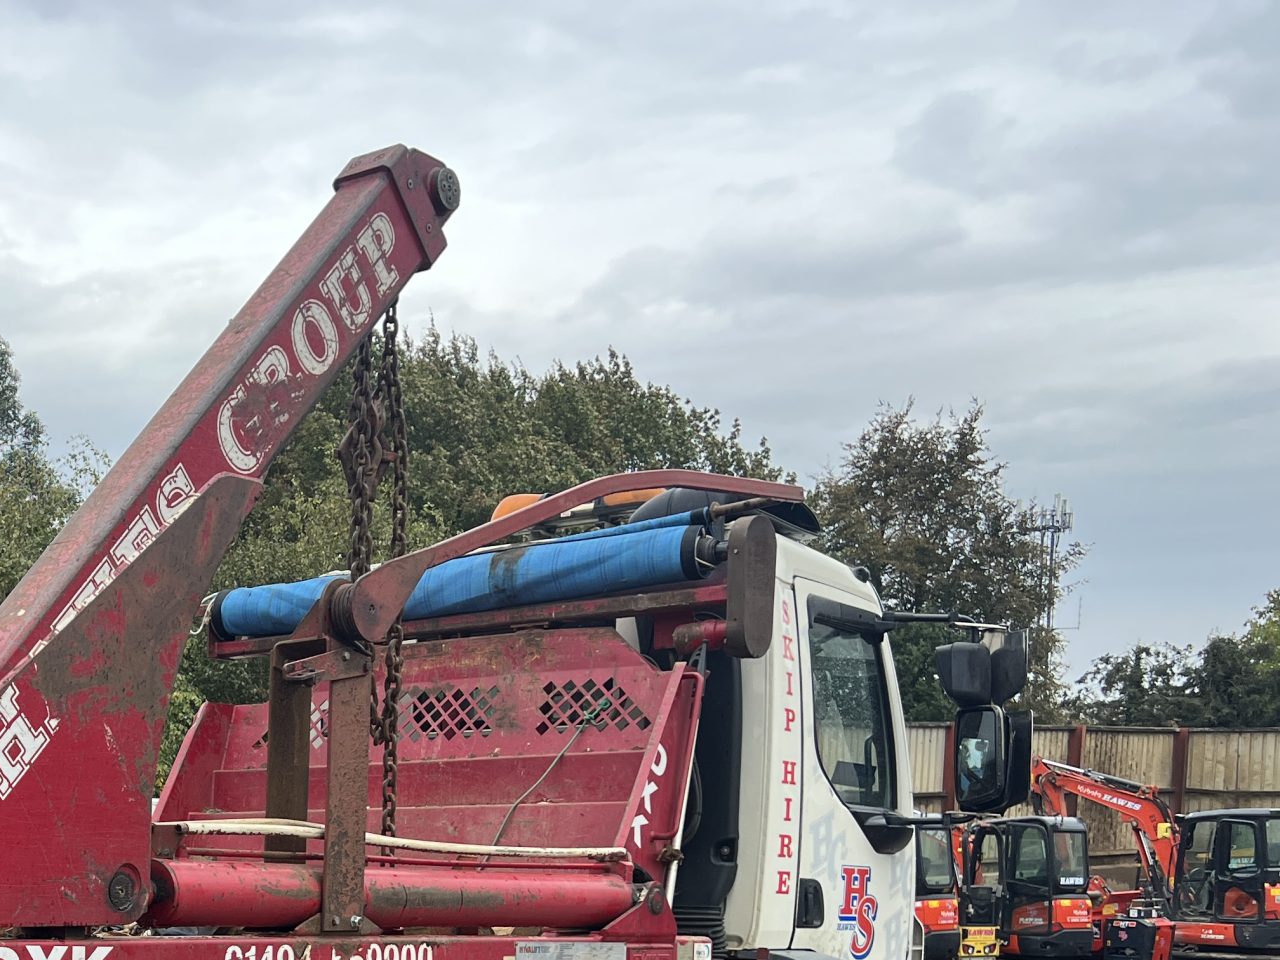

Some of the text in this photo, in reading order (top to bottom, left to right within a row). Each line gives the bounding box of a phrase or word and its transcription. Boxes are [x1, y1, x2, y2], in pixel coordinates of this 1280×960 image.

[782, 600, 796, 732] SKIP
[776, 760, 797, 895] HIRE
[1102, 793, 1142, 811] HAWES
